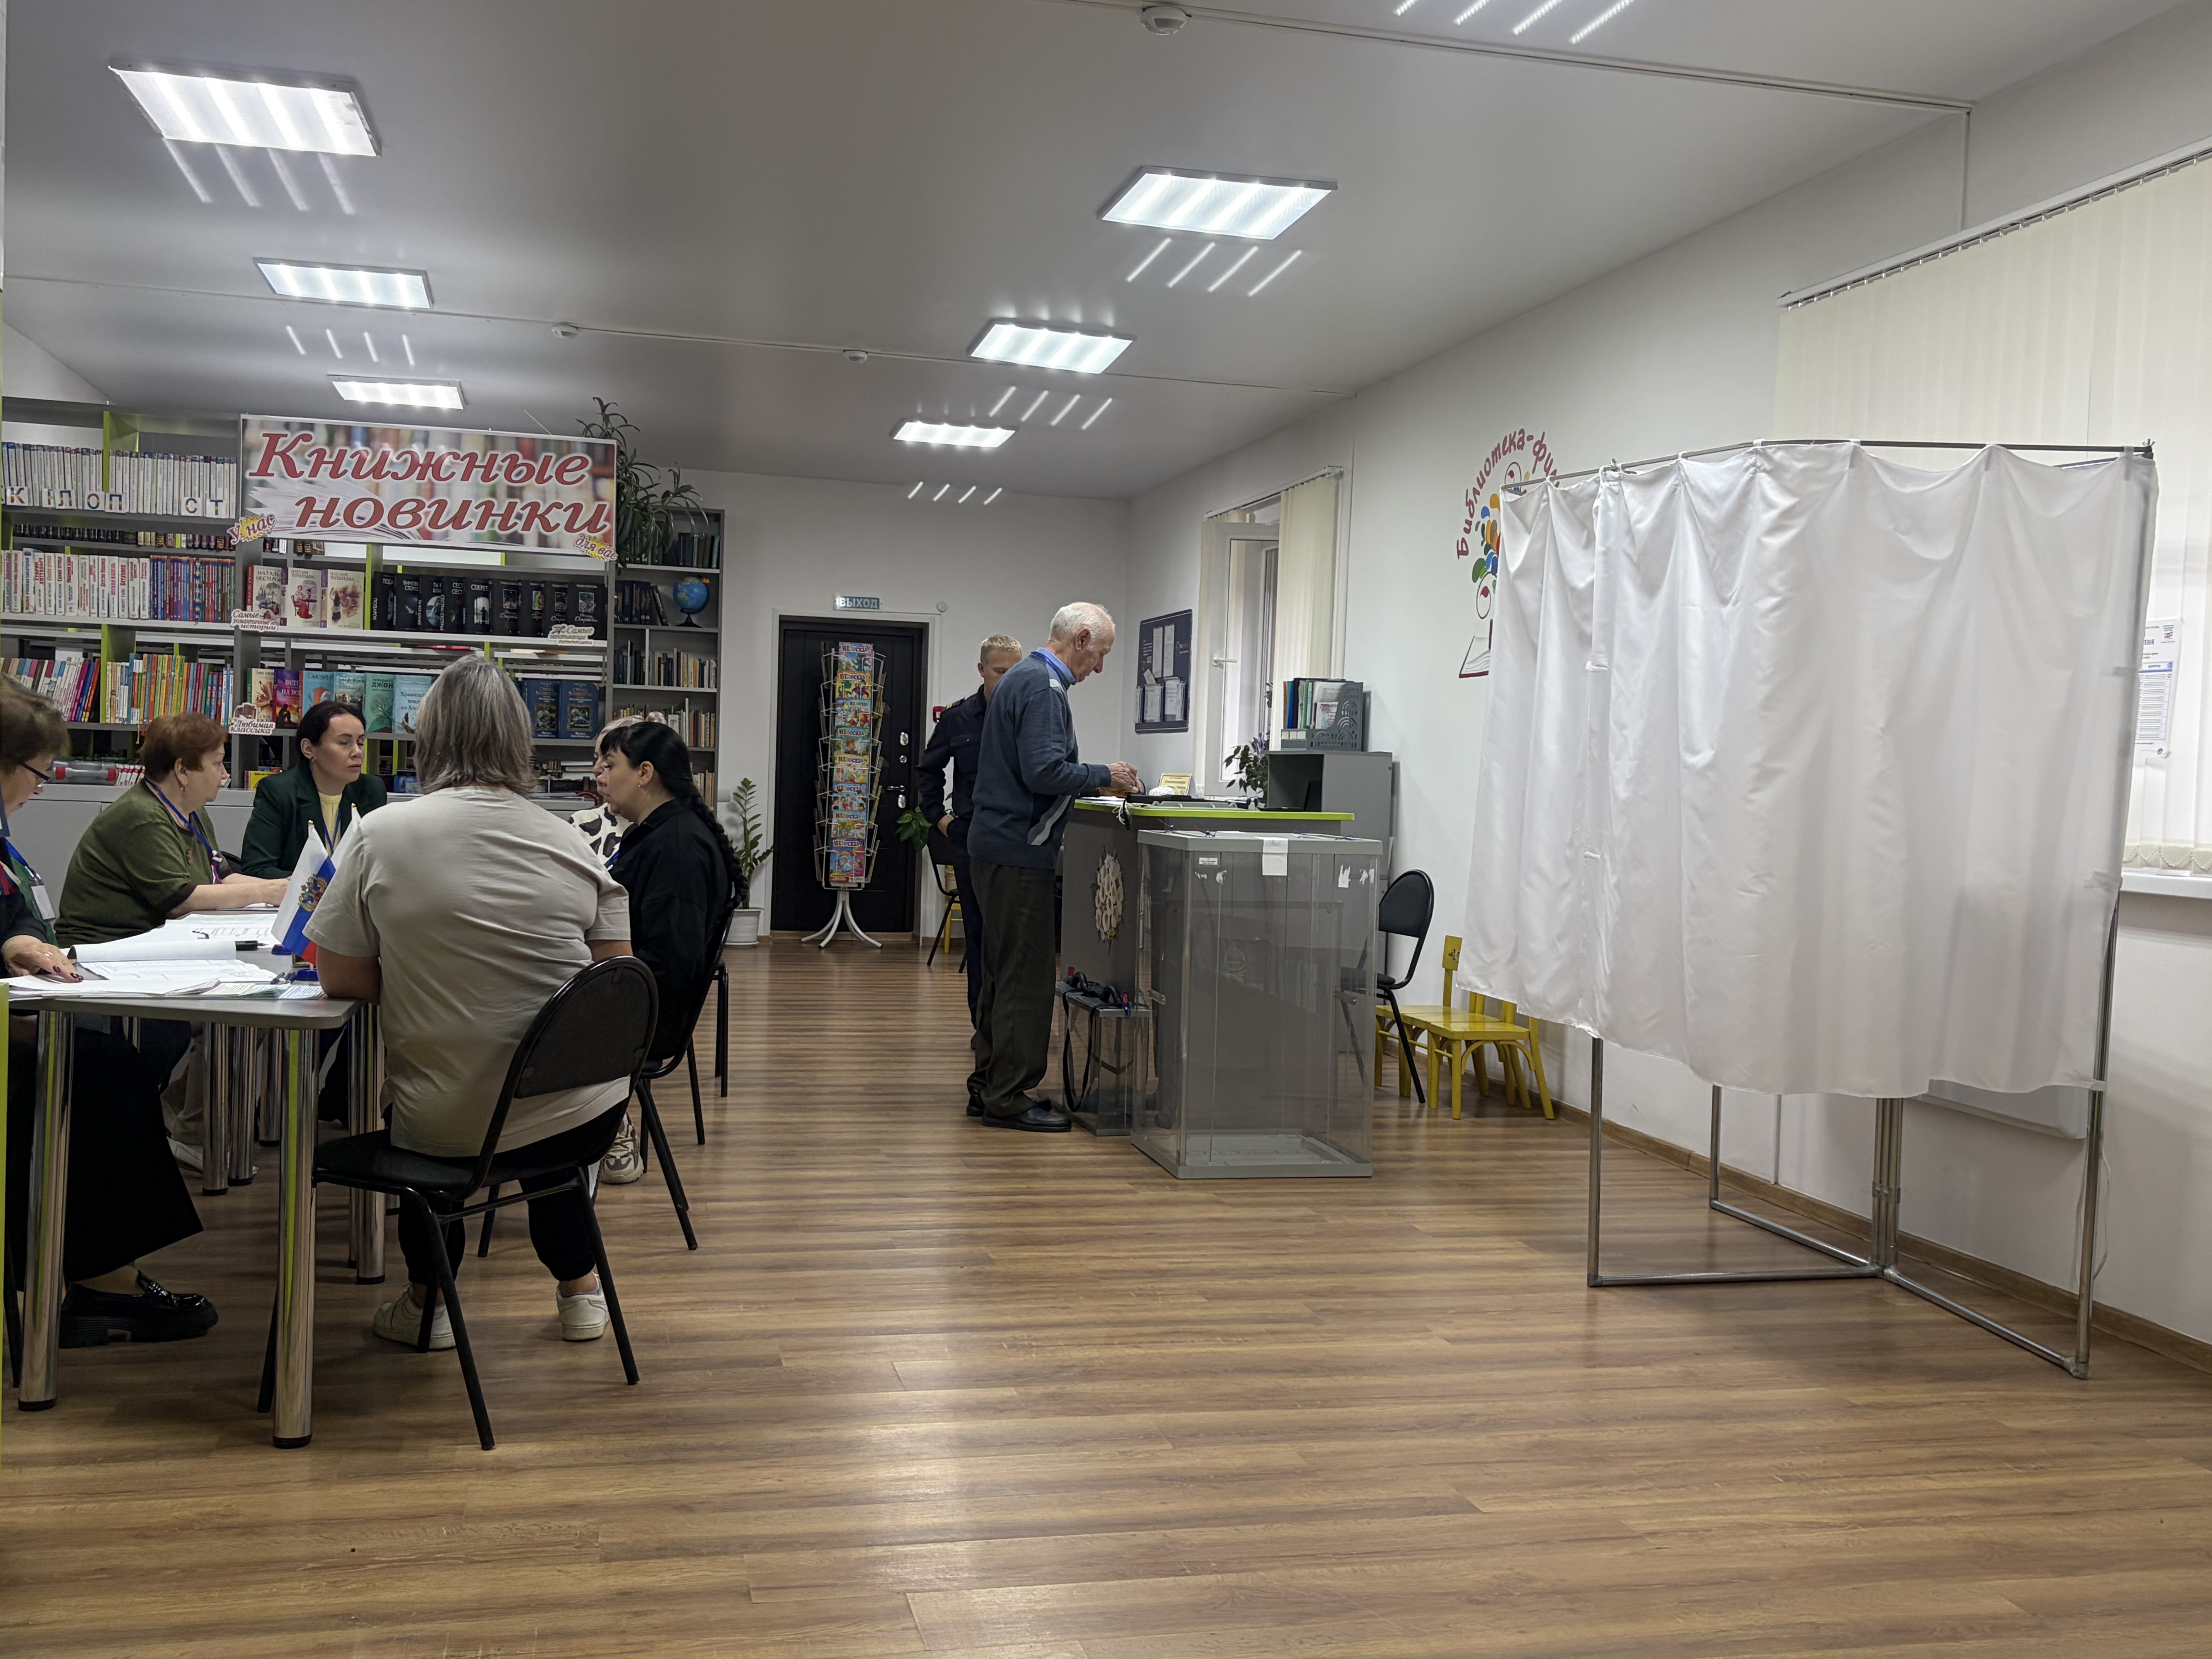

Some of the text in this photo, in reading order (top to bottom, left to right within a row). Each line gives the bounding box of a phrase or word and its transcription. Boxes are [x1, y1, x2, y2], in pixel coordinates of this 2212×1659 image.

[249, 433, 589, 485] Книжные
[10, 487, 24, 504] К
[58, 490, 72, 506] Л
[87, 493, 100, 509] О
[109, 494, 122, 510] П
[185, 498, 197, 514] С
[210, 500, 223, 515] Т
[295, 497, 610, 533] новинки
[228, 514, 275, 544] У нас
[575, 534, 617, 560] для вас
[839, 597, 878, 609] ВЫХОД
[233, 610, 259, 618] Самые
[235, 720, 273, 728] Любимая
